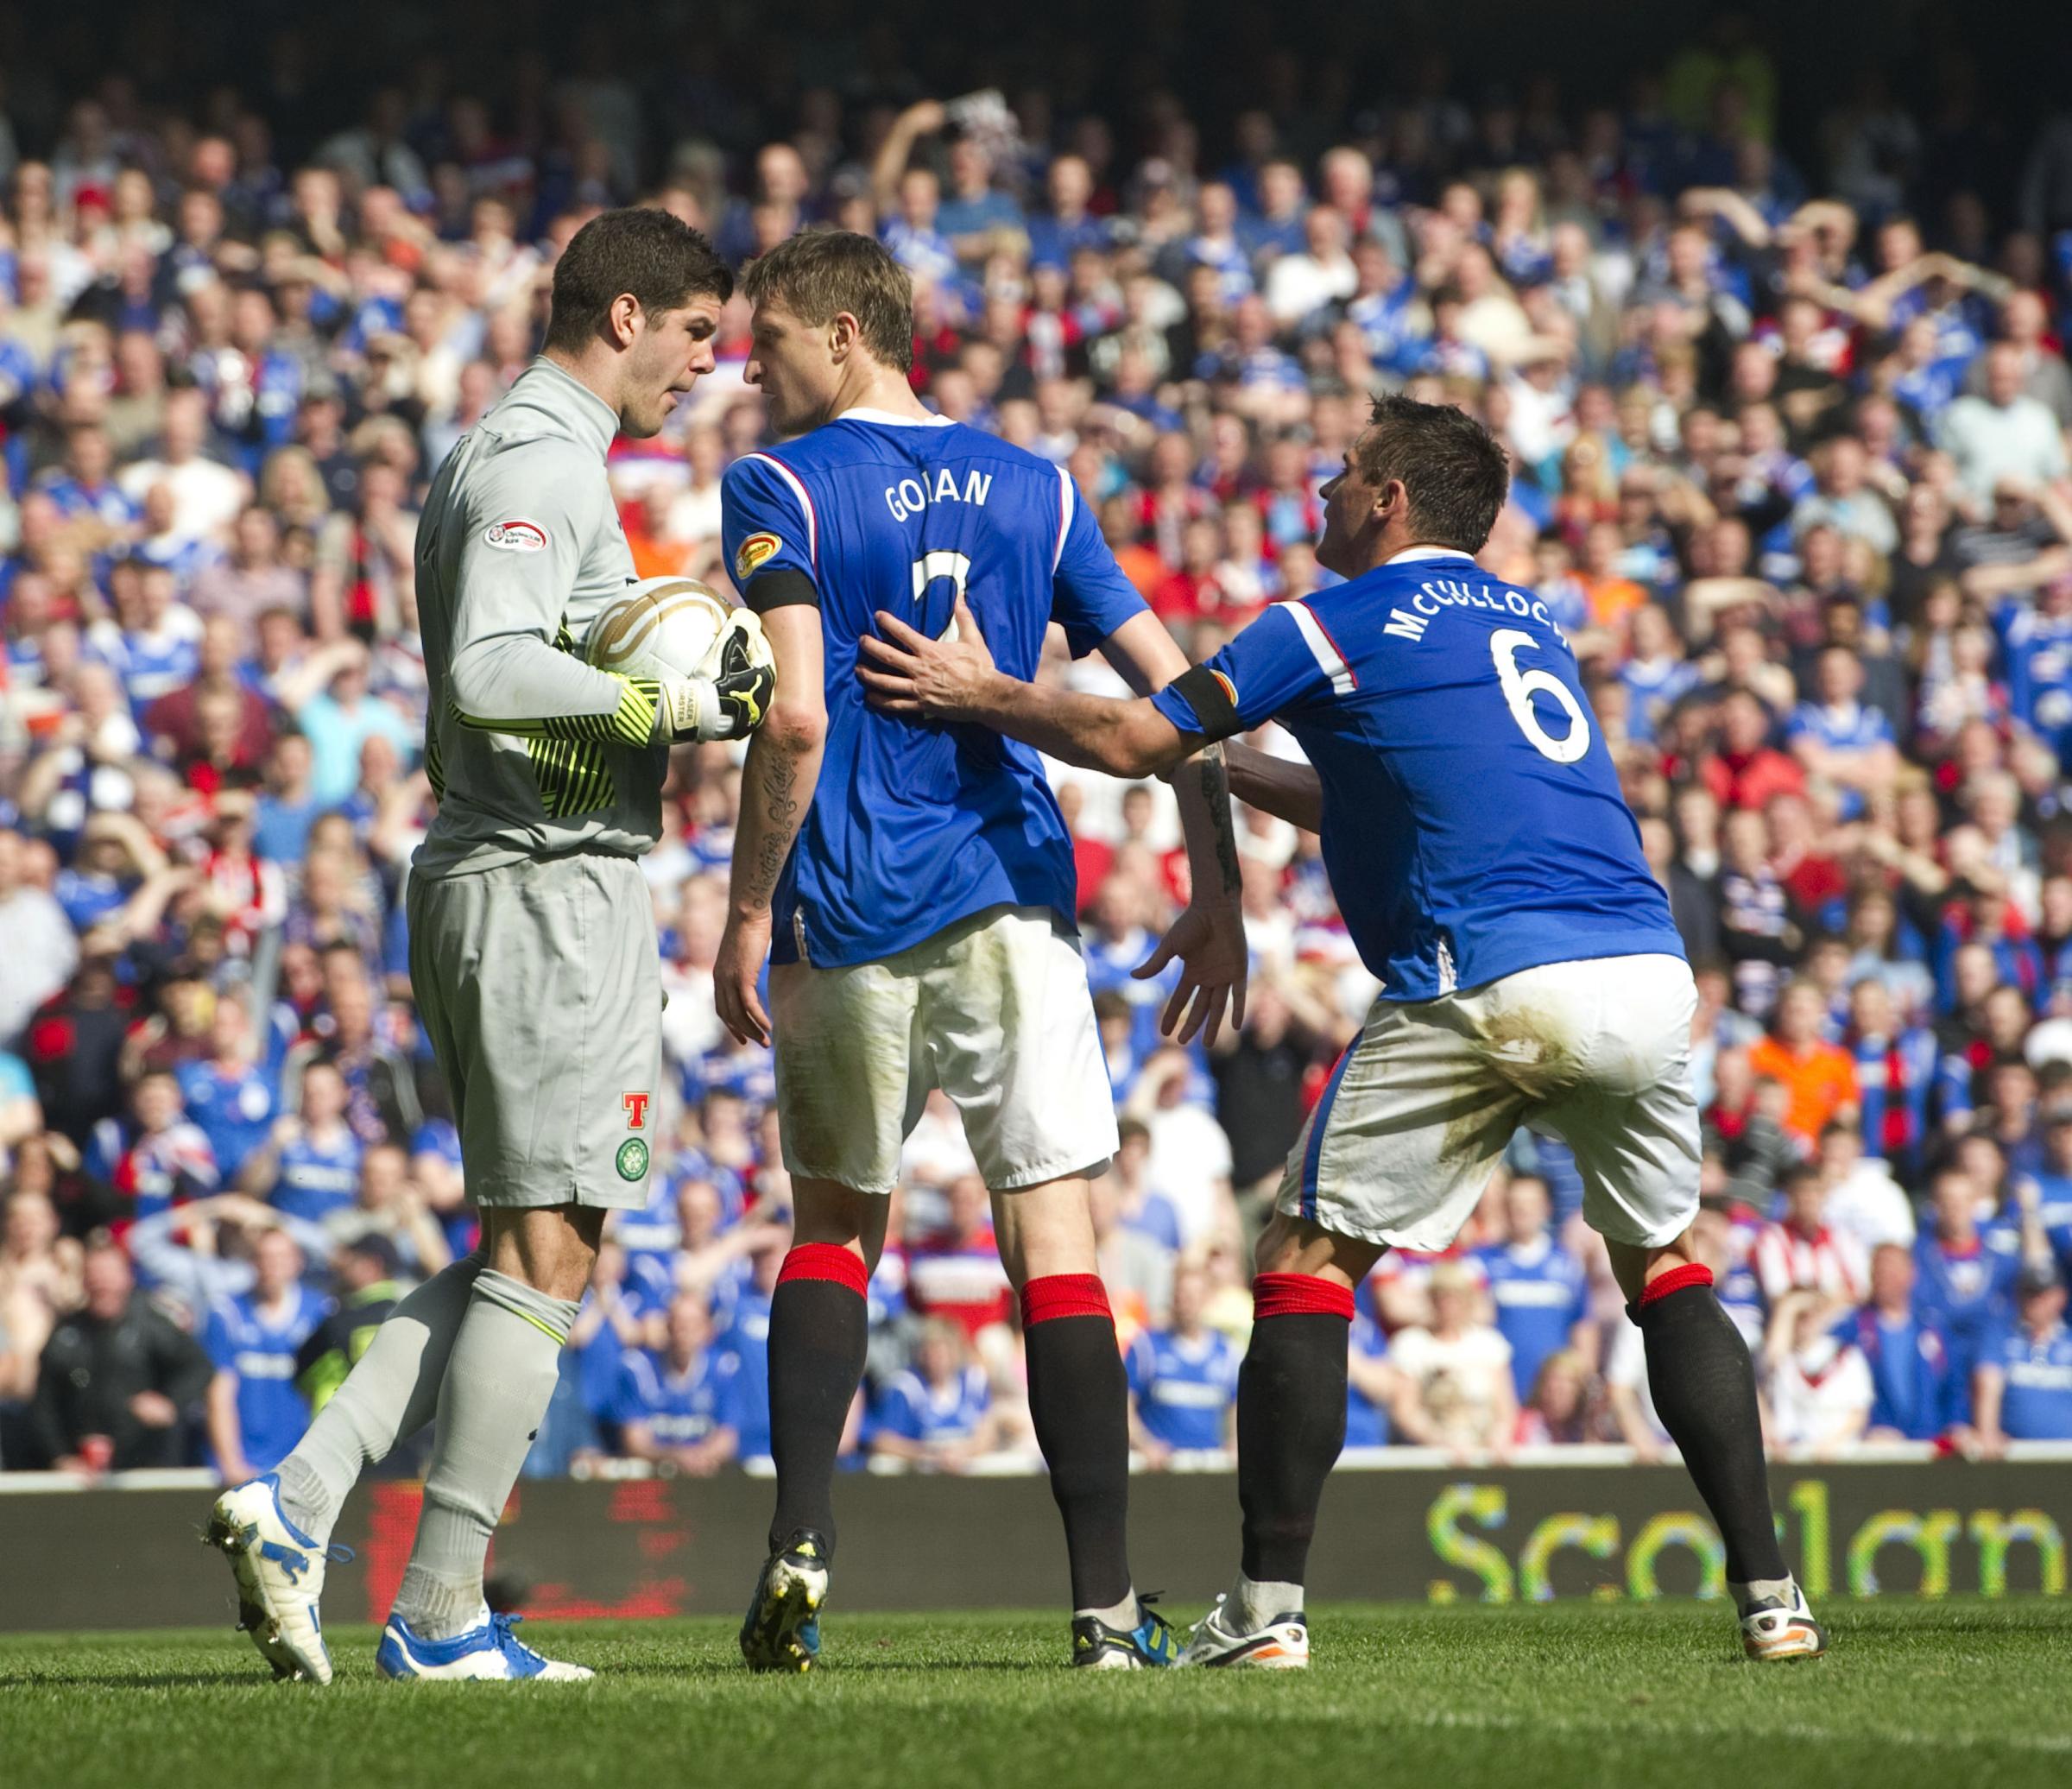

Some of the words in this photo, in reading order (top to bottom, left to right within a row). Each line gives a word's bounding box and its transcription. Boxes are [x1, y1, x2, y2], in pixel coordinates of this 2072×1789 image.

[1489, 628, 1590, 764] 6
[622, 1091, 649, 1129] T
[1426, 1481, 2069, 1603] Scolan
